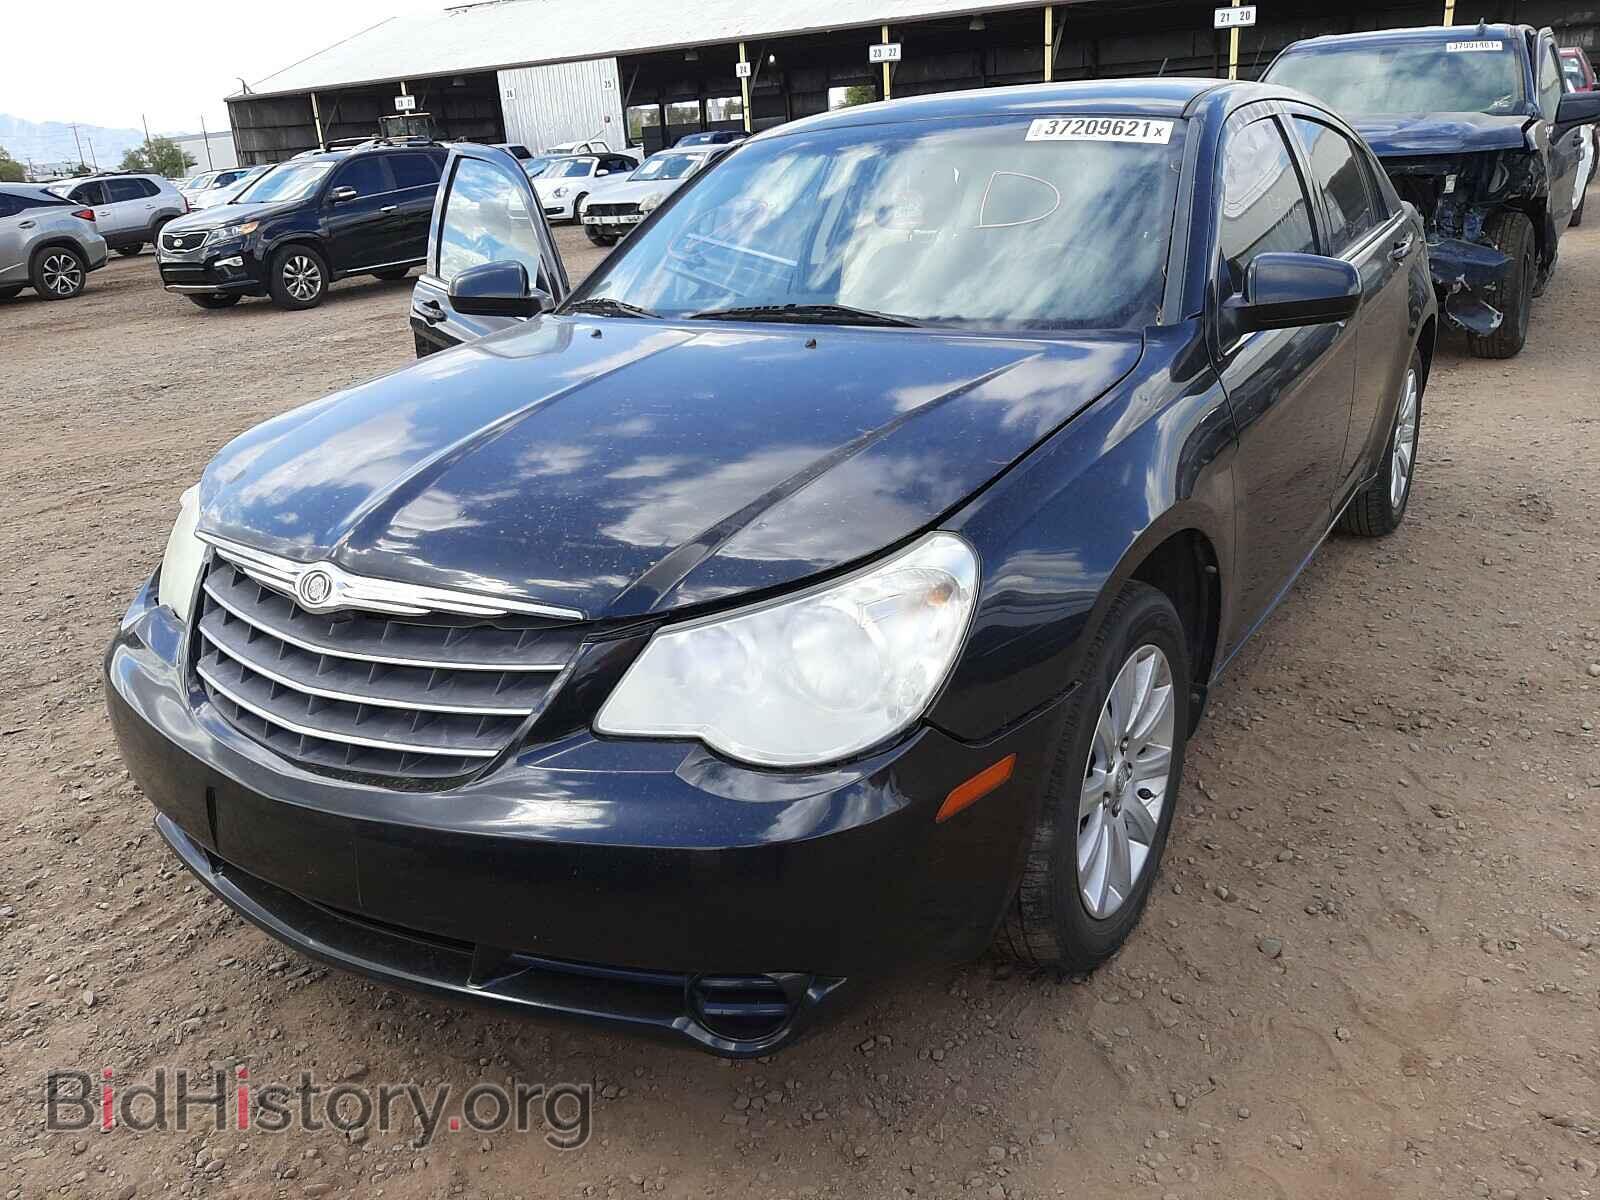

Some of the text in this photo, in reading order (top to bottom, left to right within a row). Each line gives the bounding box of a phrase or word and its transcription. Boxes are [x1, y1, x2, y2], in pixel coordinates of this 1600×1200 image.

[1220, 10, 1251, 23] 21 20
[873, 47, 897, 58] 23 22
